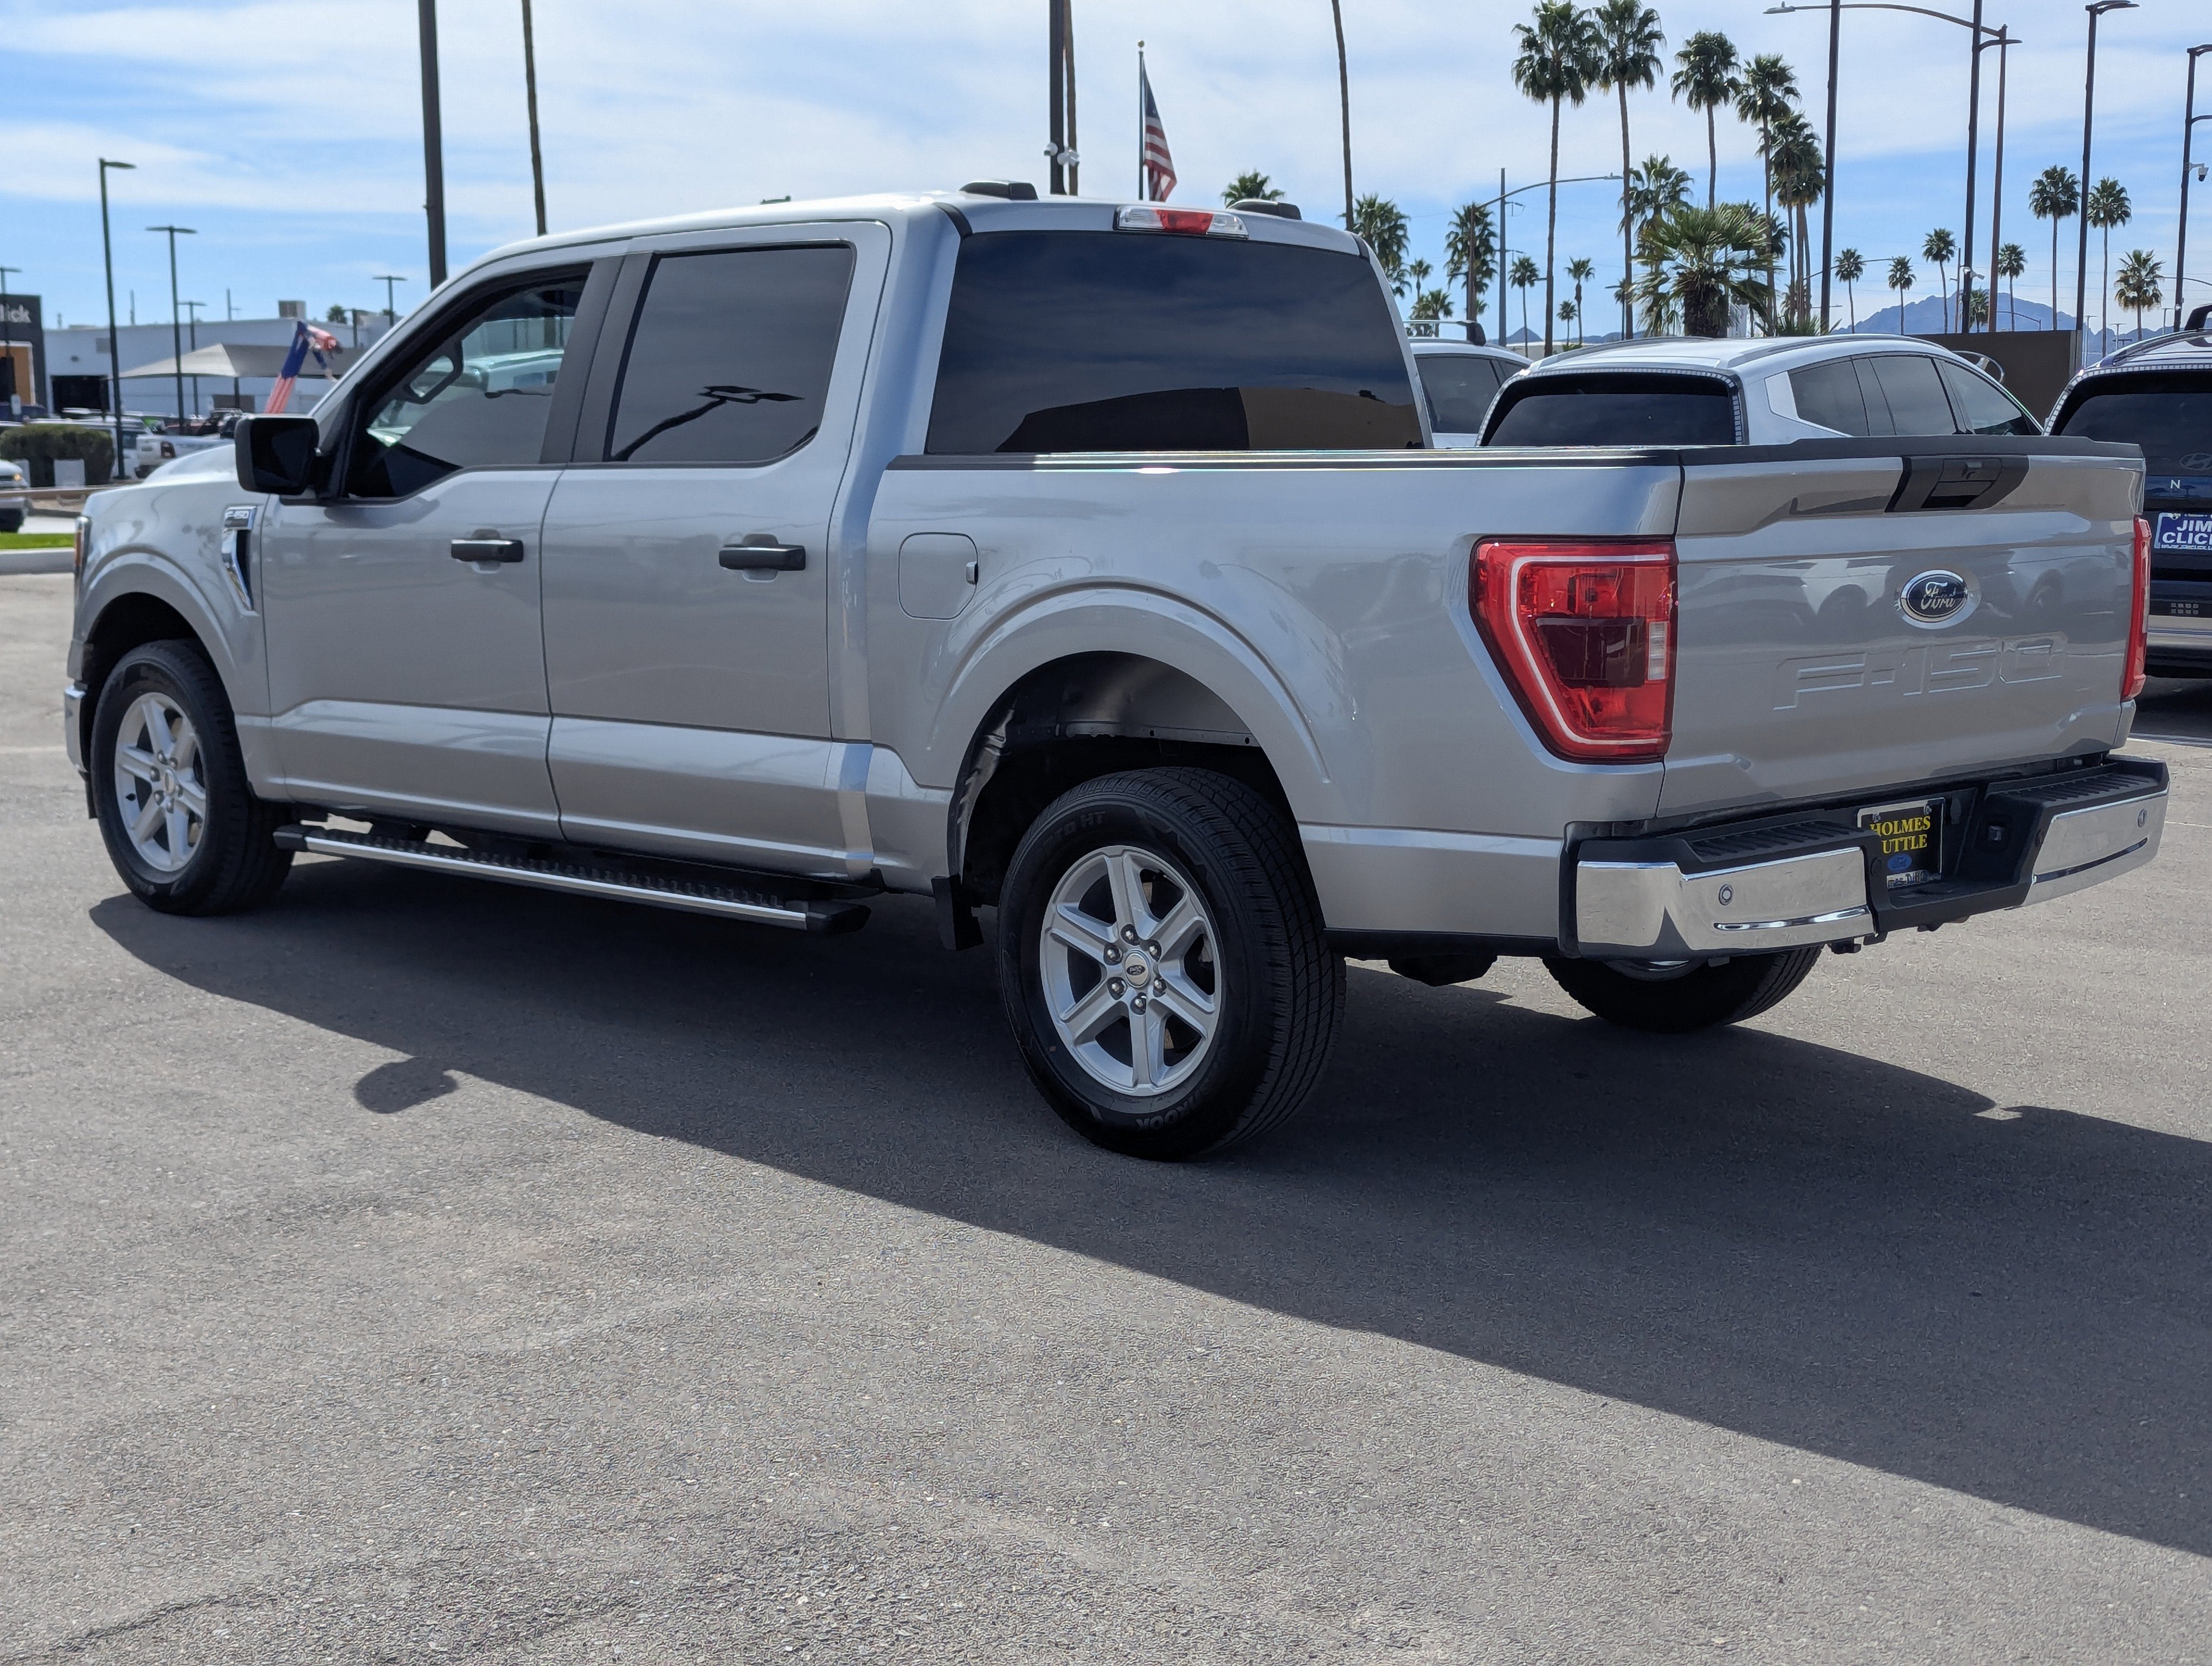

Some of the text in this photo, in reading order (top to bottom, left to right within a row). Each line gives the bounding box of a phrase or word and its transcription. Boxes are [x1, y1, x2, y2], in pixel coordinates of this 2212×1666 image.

[2176, 520, 2212, 532] JIM
[1920, 581, 1956, 610] Ford
[1773, 632, 2066, 711] F-150
[1869, 815, 1931, 837] HOLMES
[1881, 834, 1928, 854] UTTLE
